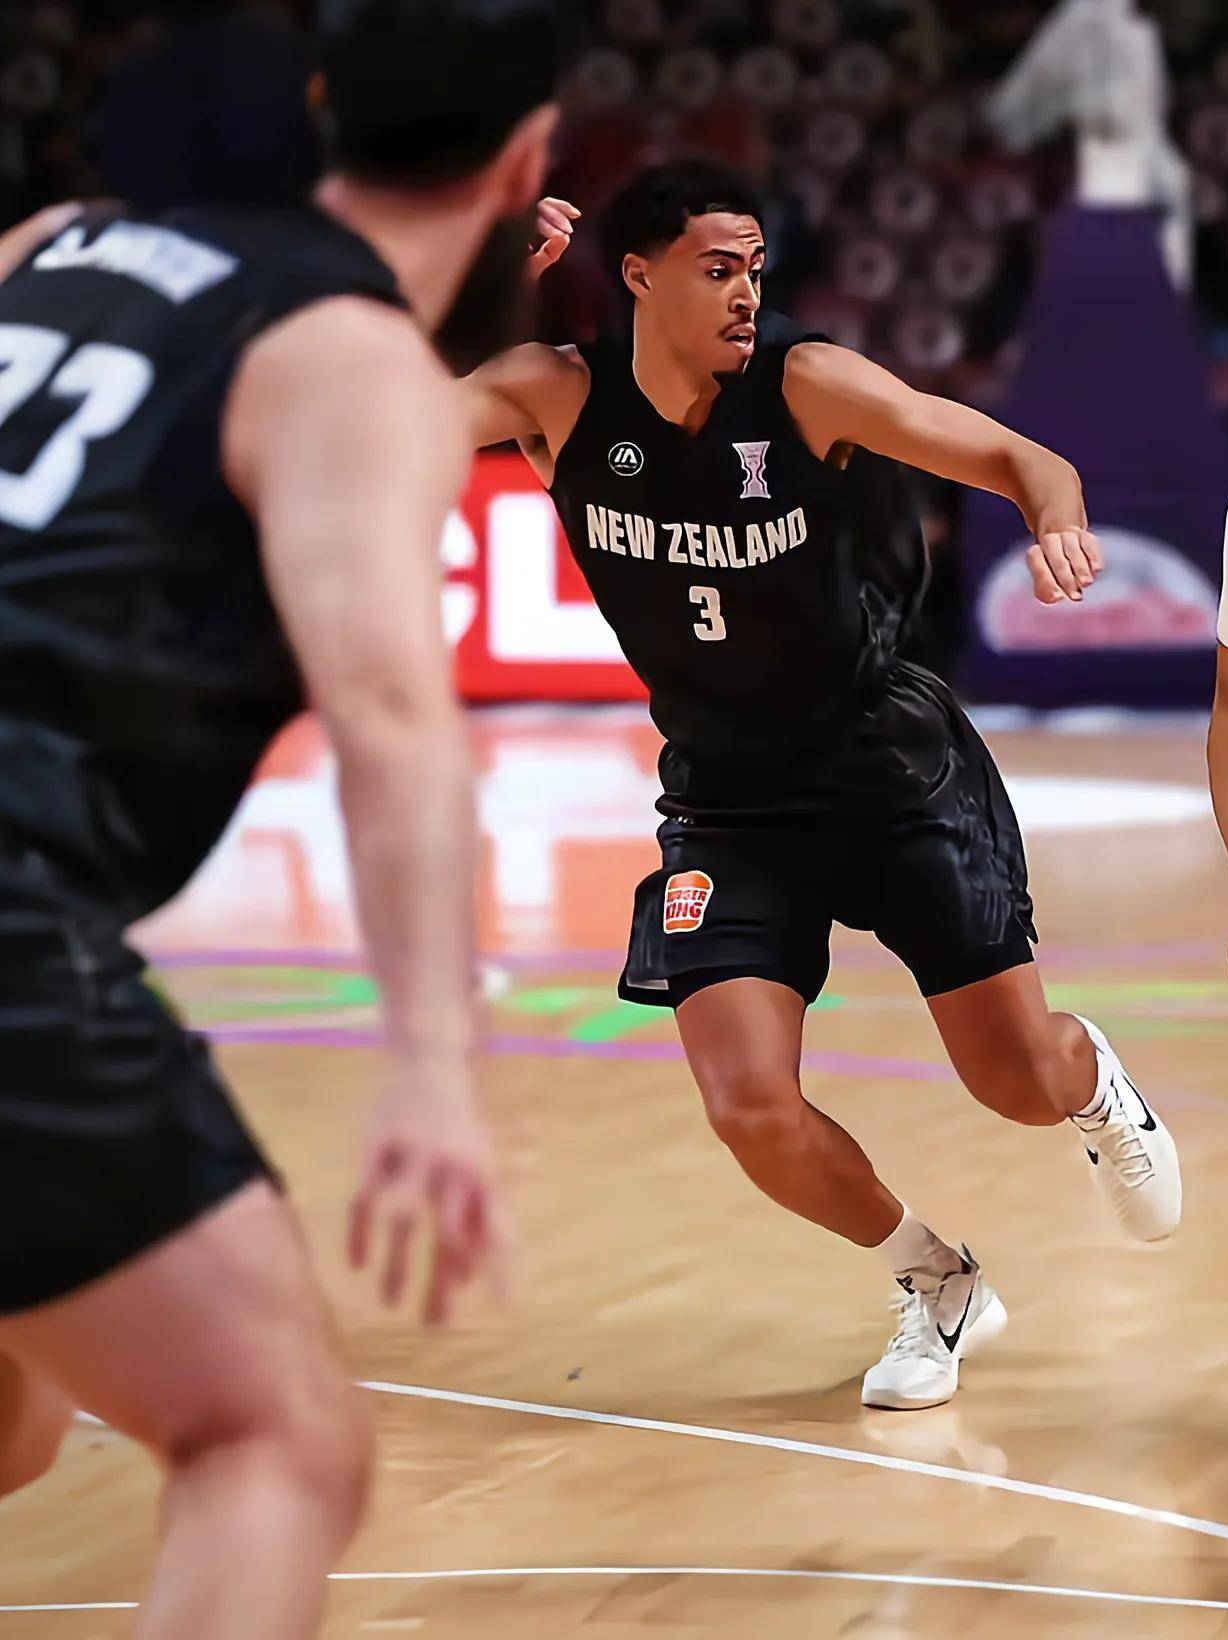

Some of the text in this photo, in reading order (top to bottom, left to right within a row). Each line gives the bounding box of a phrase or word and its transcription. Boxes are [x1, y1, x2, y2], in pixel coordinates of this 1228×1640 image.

[586, 504, 808, 569] NEW ZEALAND
[438, 494, 627, 662] L
[689, 586, 727, 641] 3
